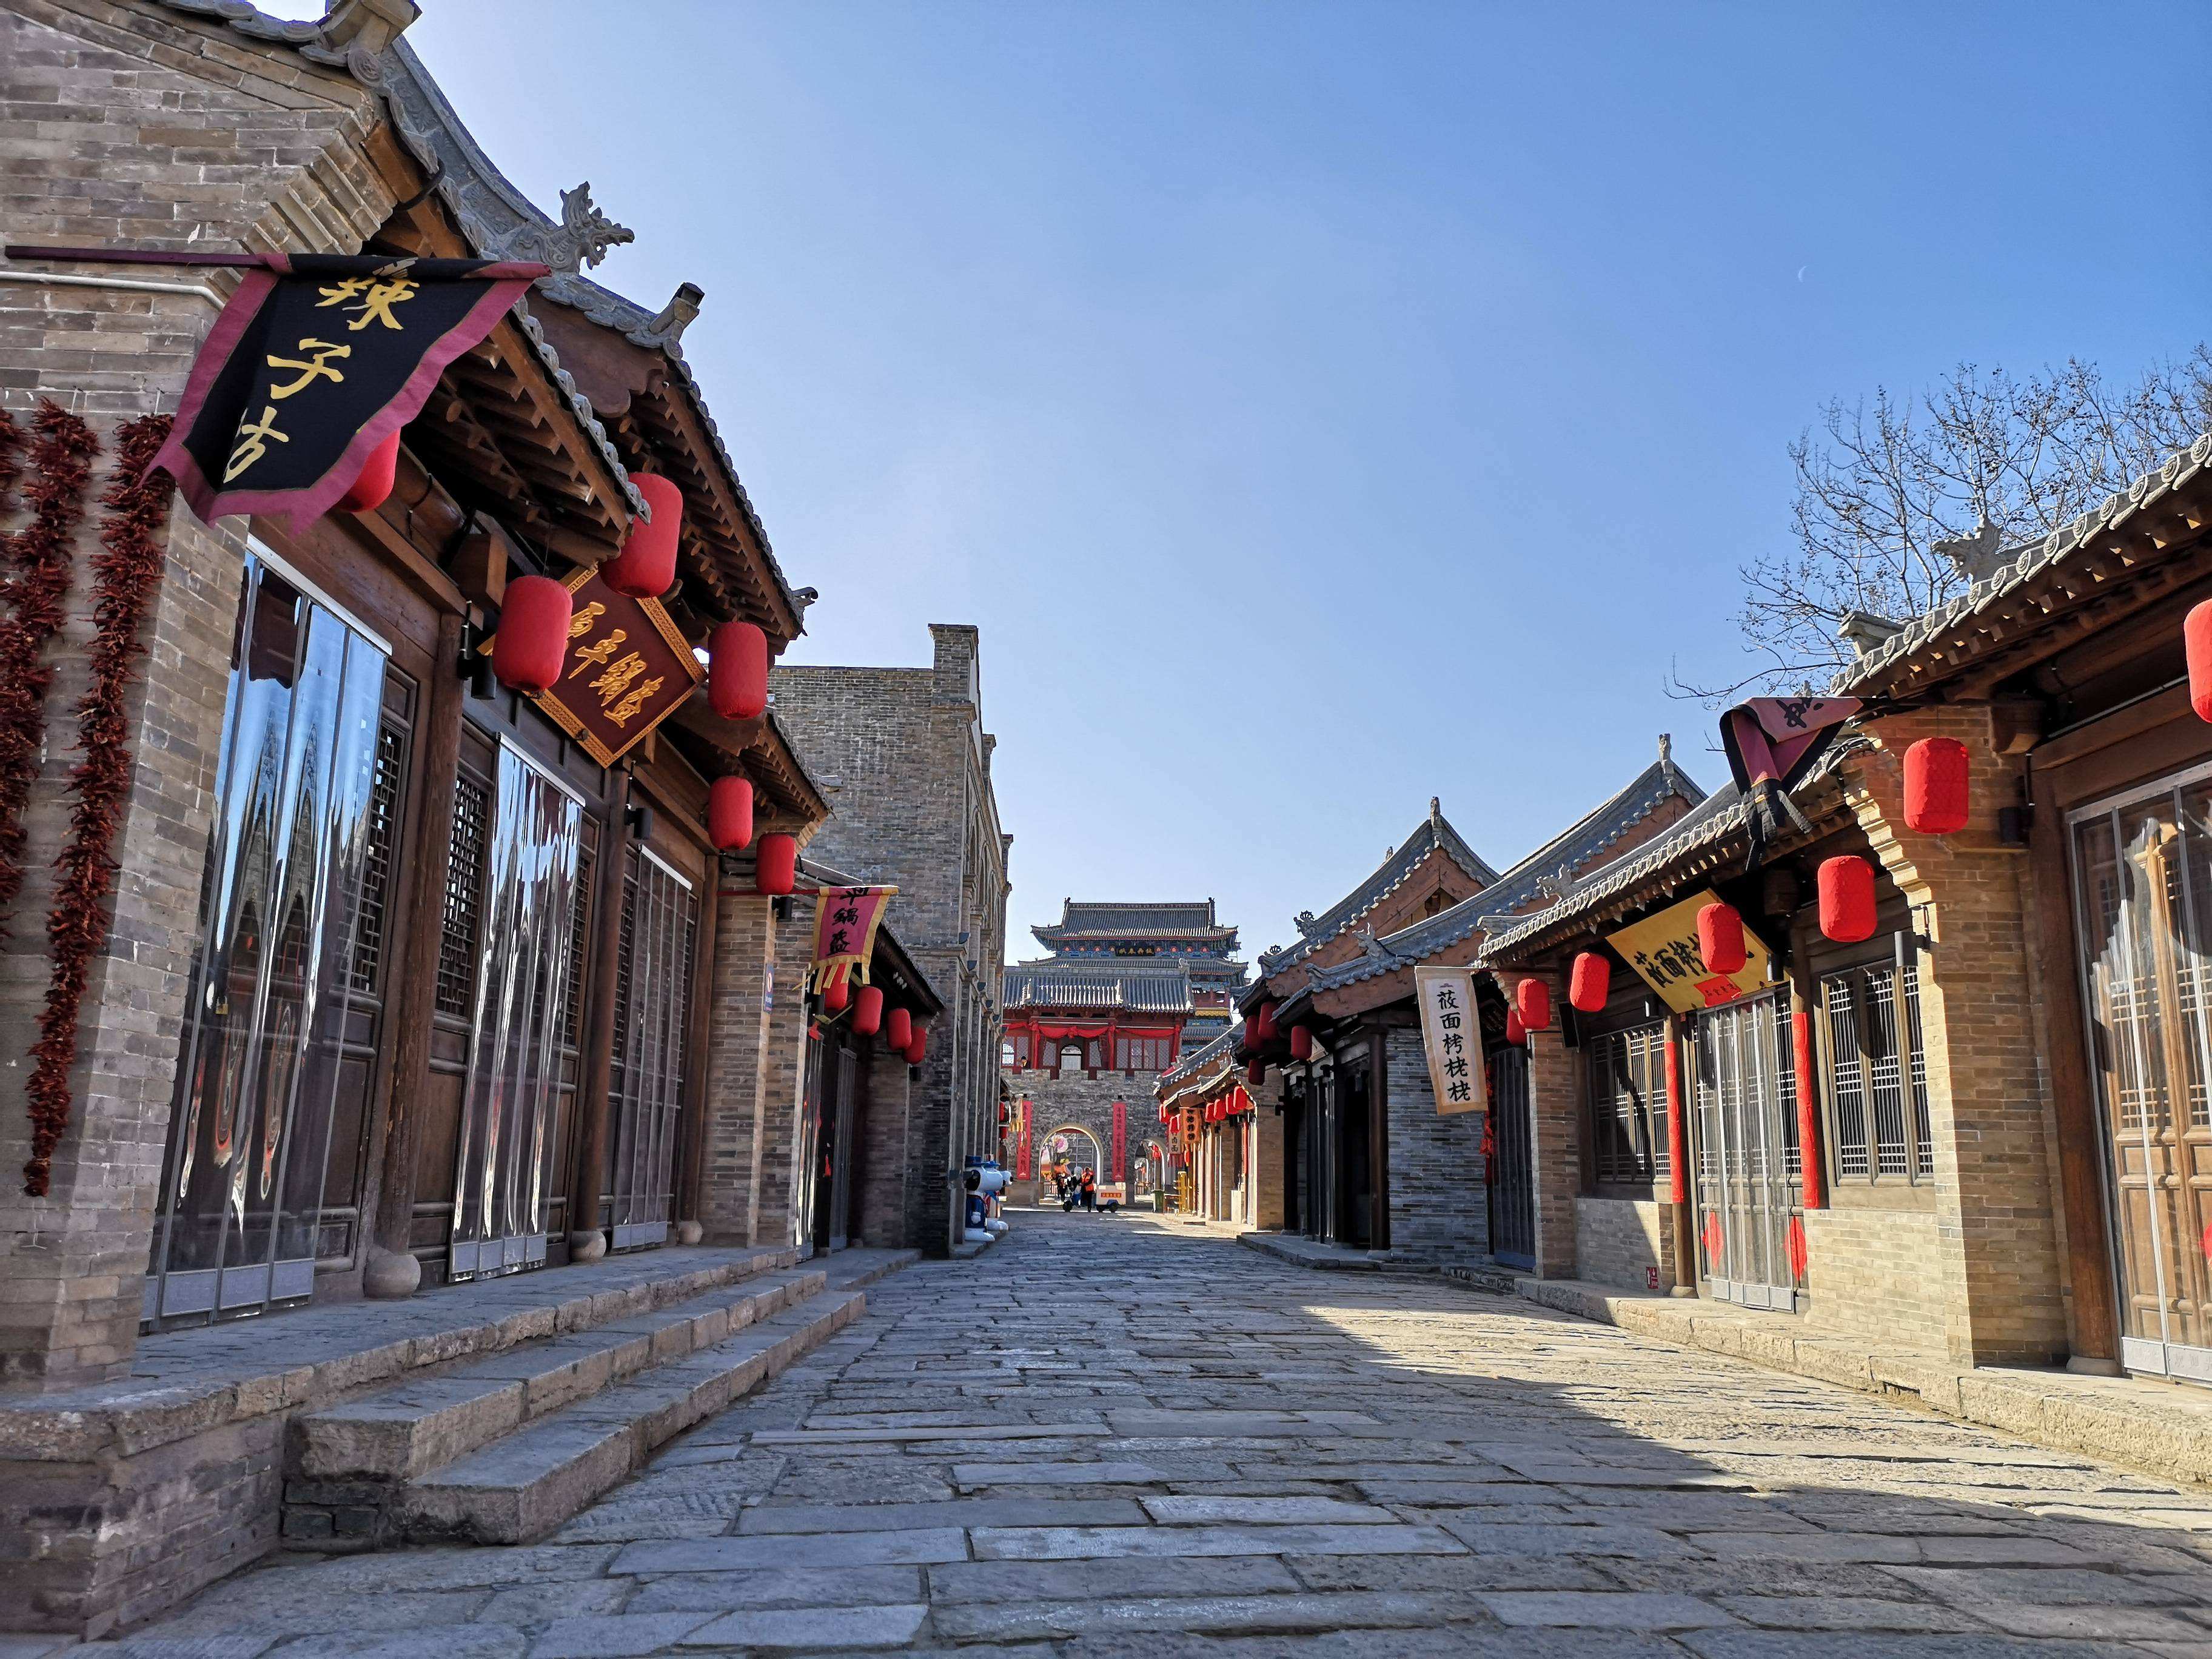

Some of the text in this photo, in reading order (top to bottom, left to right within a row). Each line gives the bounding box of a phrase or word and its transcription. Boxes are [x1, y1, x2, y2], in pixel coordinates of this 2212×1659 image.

[1436, 989, 1471, 1102] 莜面栲栳栳
